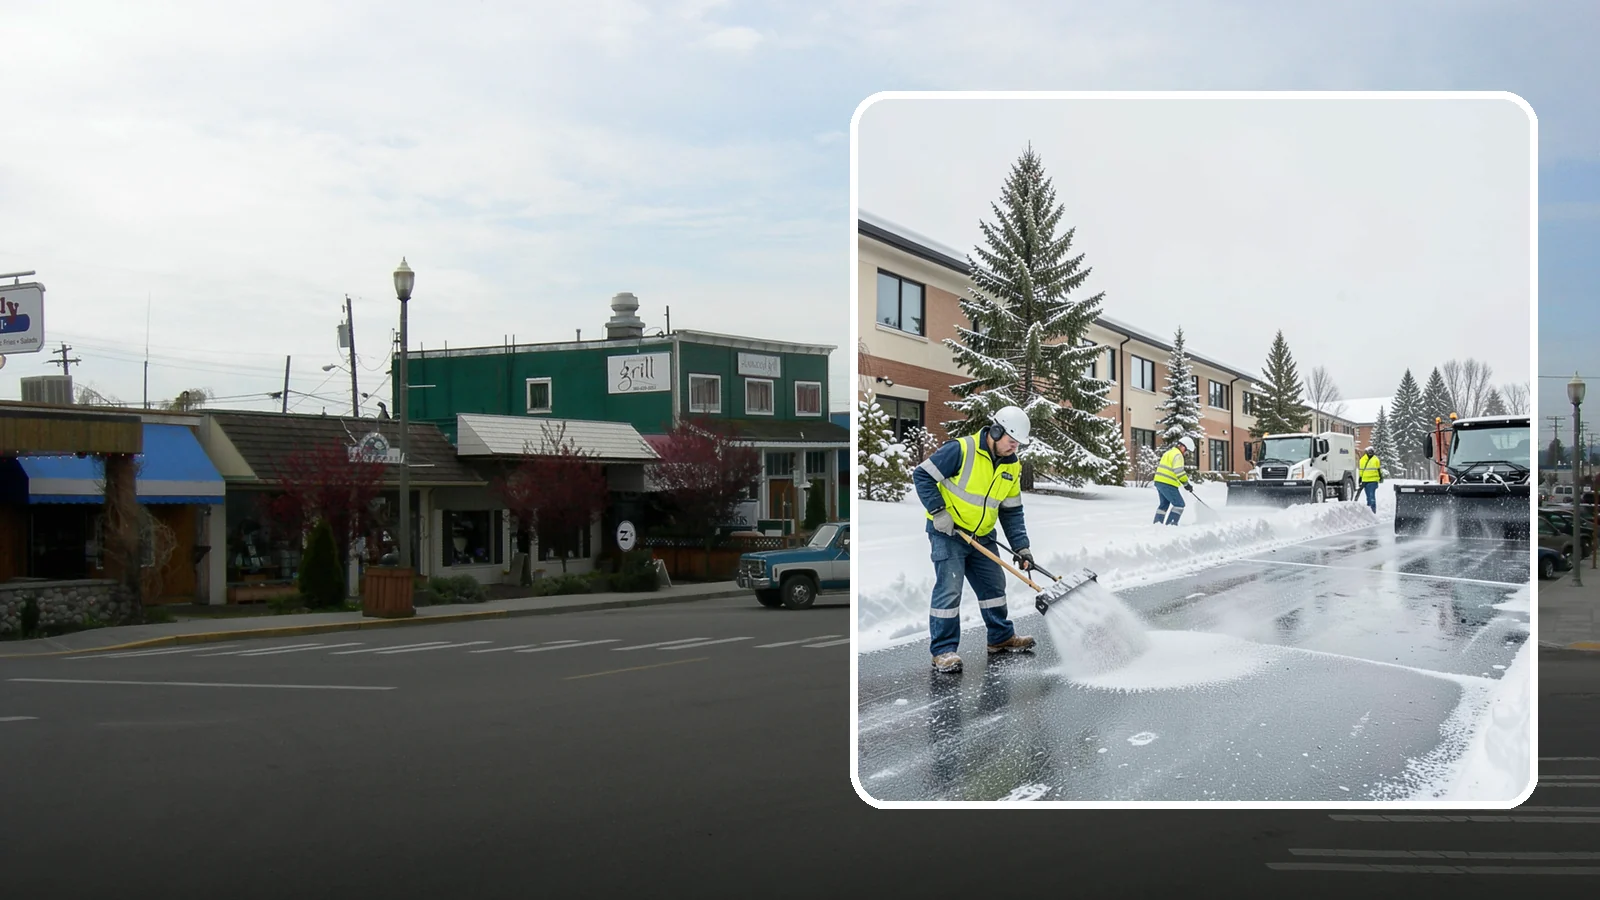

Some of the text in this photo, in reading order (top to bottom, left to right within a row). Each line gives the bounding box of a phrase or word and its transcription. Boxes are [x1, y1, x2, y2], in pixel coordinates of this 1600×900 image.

[0, 296, 19, 325] ly
[20, 337, 38, 345] Salads
[617, 355, 655, 391] grill
